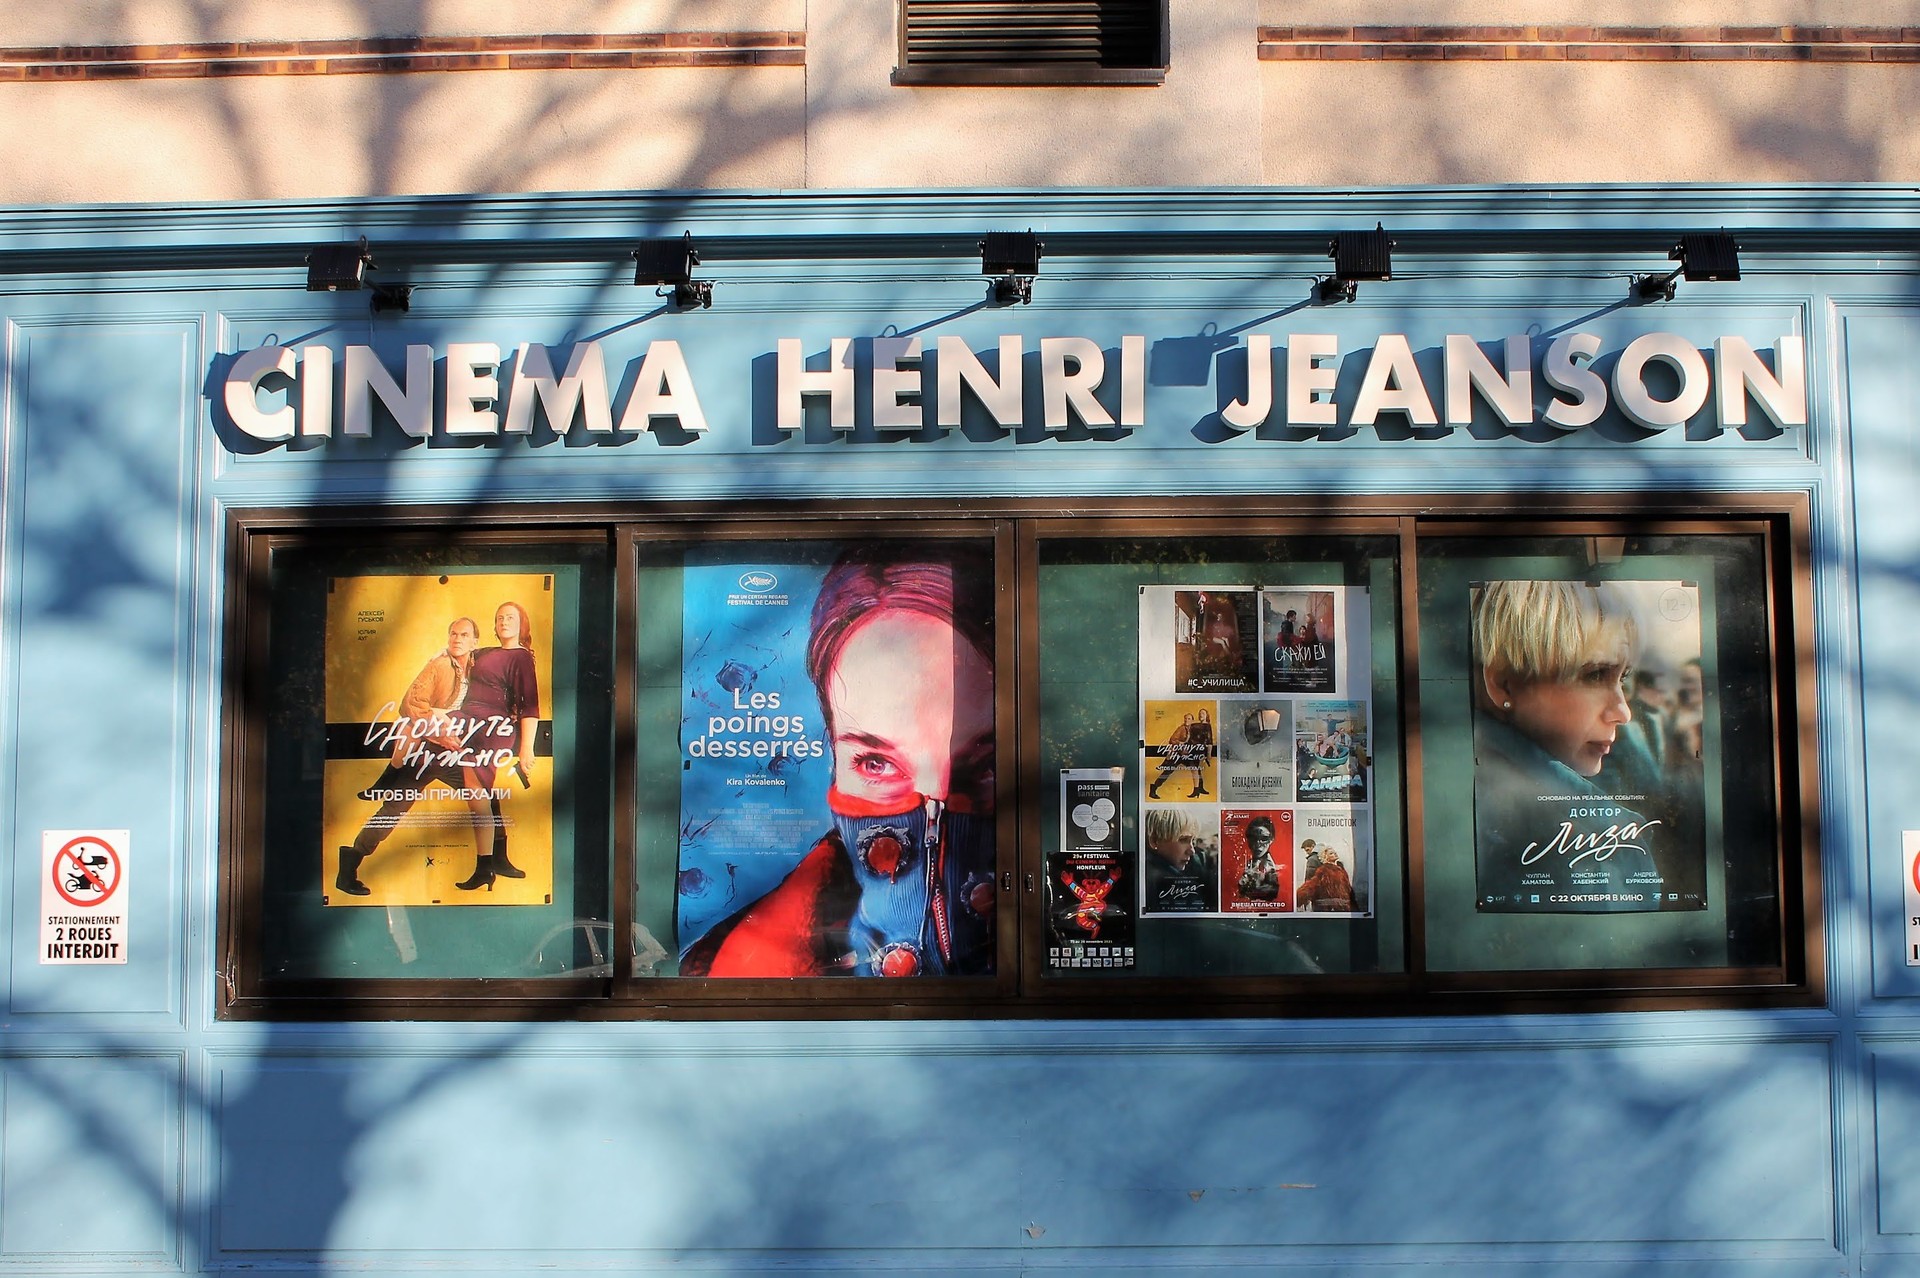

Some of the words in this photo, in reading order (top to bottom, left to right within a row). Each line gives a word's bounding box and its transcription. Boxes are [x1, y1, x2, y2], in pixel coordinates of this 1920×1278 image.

[225, 340, 710, 441] CINEMA
[777, 335, 1145, 431] HENRI
[1221, 332, 1806, 430] JEANSON
[1274, 644, 1311, 662] СКАЖИ
[1313, 643, 1326, 661] ЕЙ
[733, 688, 781, 709] Les
[708, 712, 804, 737] poings
[688, 735, 824, 758] desserrés
[726, 778, 743, 786] Kira
[744, 778, 786, 786] Kovalenko
[1077, 784, 1094, 792] pass
[1299, 774, 1363, 791] ХАНДРА
[364, 788, 403, 801] ЧТОБ
[405, 788, 427, 801] ВЫ
[430, 788, 511, 801] ПРИЕХАЛИ
[1569, 807, 1621, 818] ДОКТОР
[1307, 818, 1357, 828] ВЛАДИВОСТОК
[1521, 820, 1662, 868] Лиза
[1549, 894, 1557, 902] С
[1557, 894, 1568, 902] 22
[1570, 894, 1611, 902] ОКТЯБРЯ
[48, 916, 120, 925] STATIONNEMENT
[55, 928, 64, 941] 2
[68, 928, 111, 941] ROUES
[47, 943, 119, 959] INTERDIT
